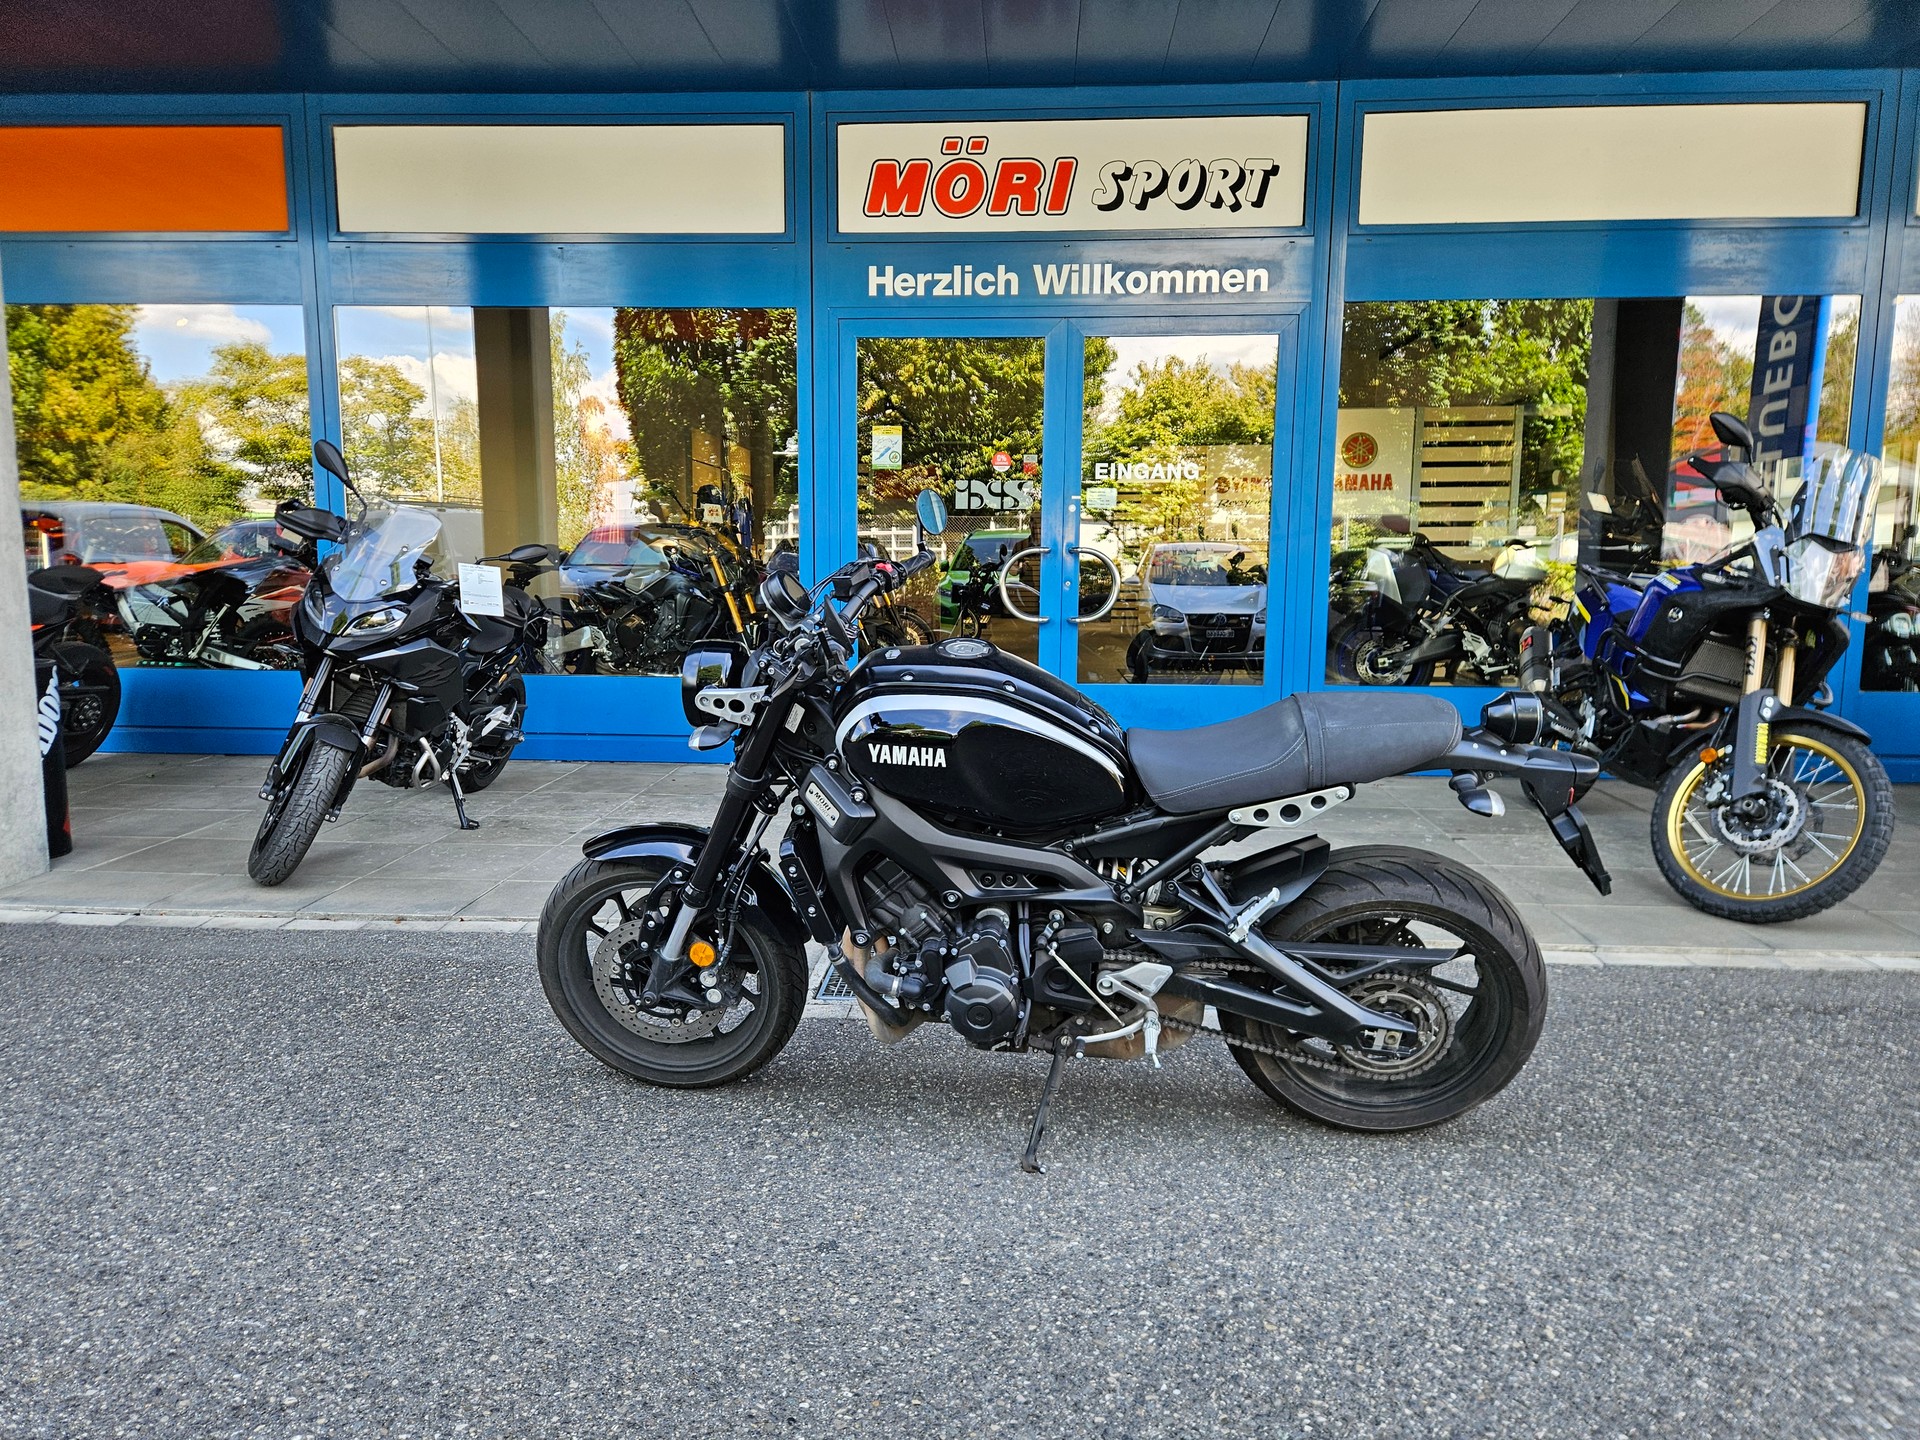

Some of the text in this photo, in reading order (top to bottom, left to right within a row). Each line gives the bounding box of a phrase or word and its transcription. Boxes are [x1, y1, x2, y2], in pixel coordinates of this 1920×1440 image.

[863, 136, 1280, 219] MÖRI SPORT
[868, 263, 1269, 296] Herzlich Willkommen
[1095, 462, 1200, 480] EINGANG
[868, 743, 947, 768] YAMAHA
